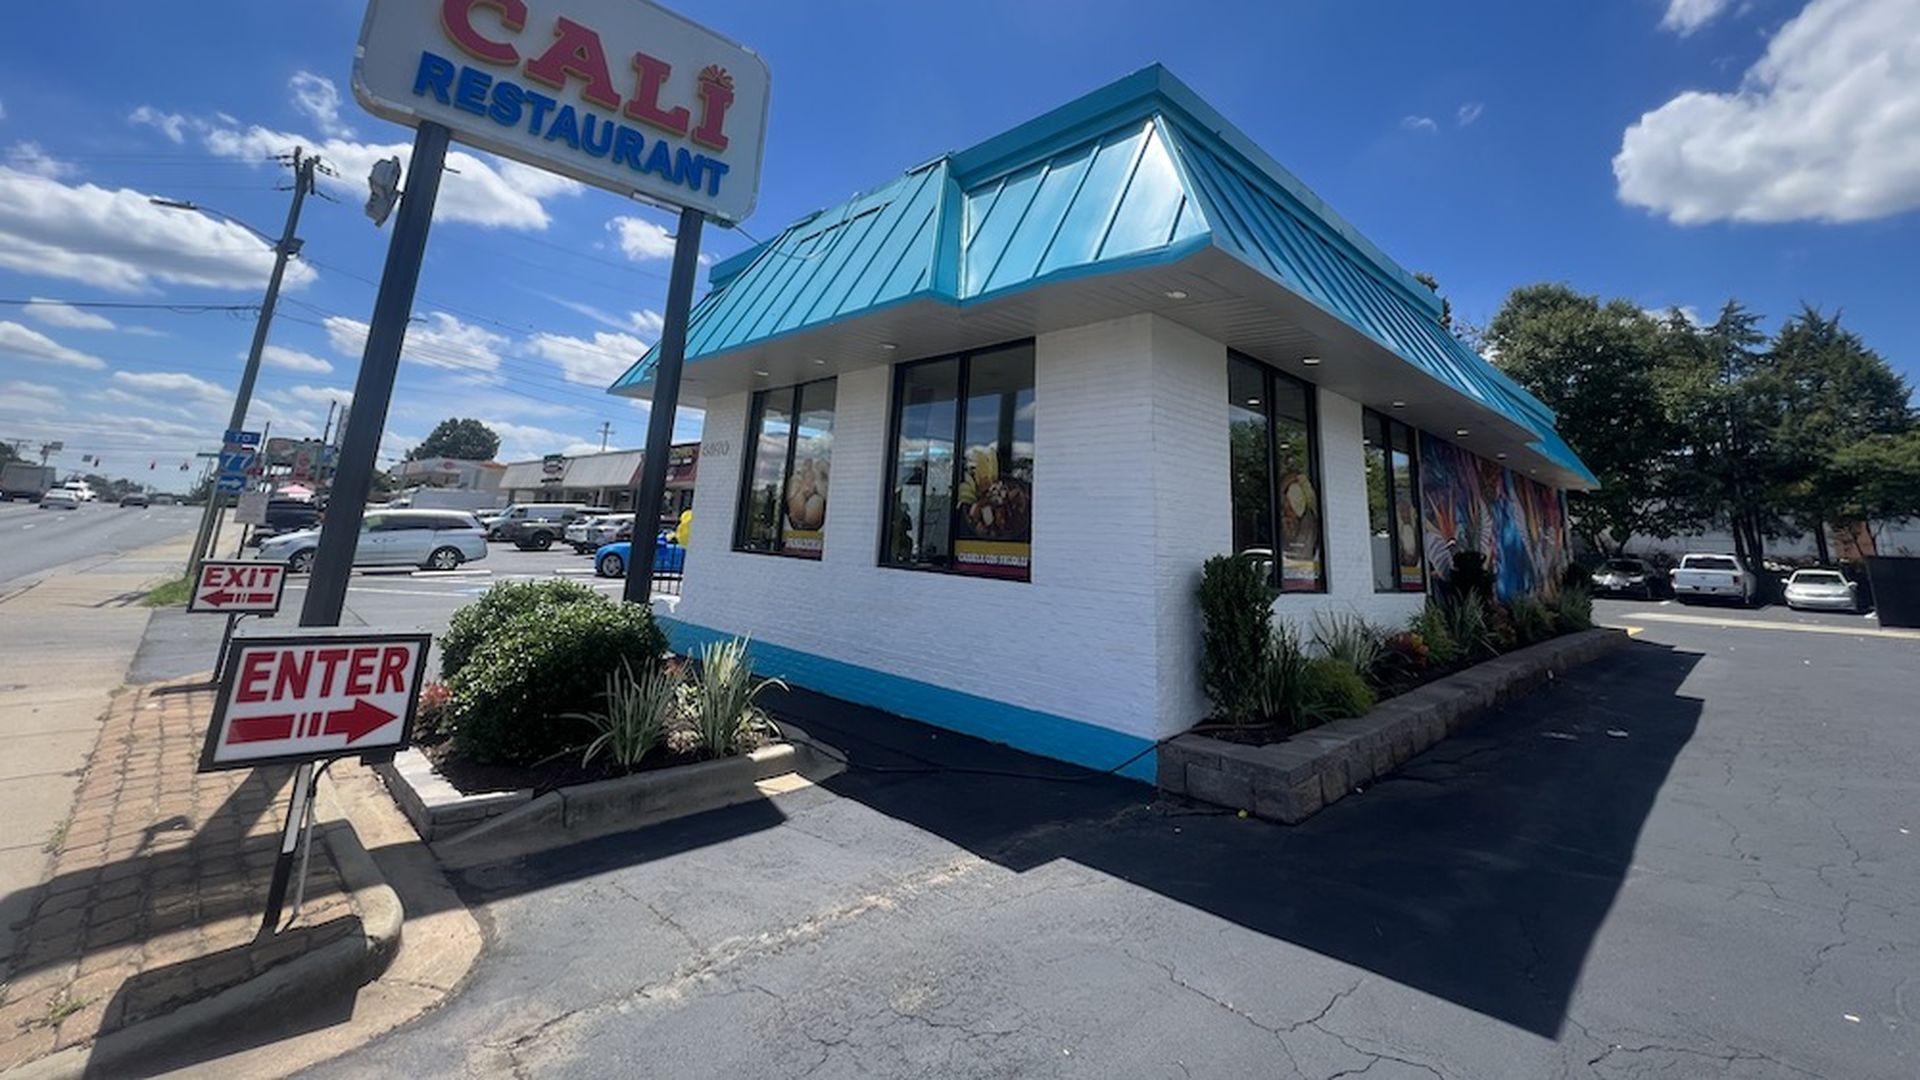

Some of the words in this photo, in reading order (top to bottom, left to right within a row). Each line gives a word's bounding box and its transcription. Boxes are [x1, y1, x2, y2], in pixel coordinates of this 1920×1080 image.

[440, 0, 734, 152] CALI
[412, 50, 731, 197] RESTAURANT
[234, 433, 252, 443] TO
[224, 451, 252, 470] 77
[202, 567, 279, 588] EXIT
[235, 646, 410, 704] ENTER
